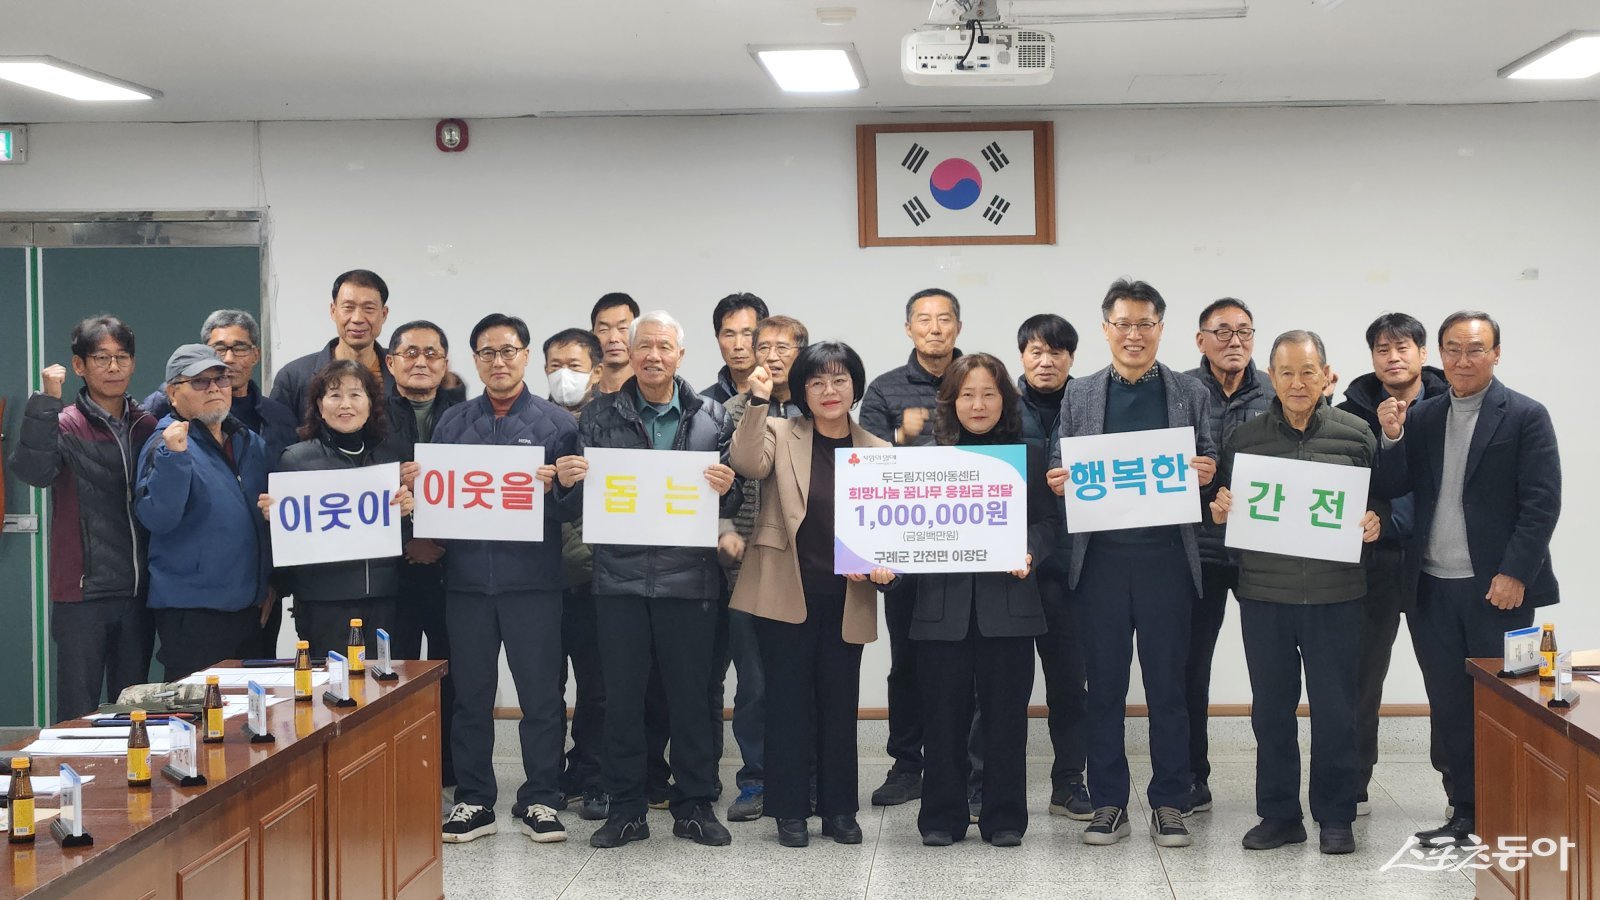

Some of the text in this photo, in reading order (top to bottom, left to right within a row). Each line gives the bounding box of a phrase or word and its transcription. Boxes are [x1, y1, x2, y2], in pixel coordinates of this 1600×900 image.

[882, 470, 980, 483] 두드림지역아동센터
[1069, 453, 1188, 502] 행복한
[423, 469, 535, 510] 이웃을
[848, 484, 1013, 500] 희망나눔 꿈나무 응원금 전달
[279, 489, 391, 533] 이웃이
[854, 500, 1008, 529] 1,000,000원
[902, 530, 959, 542] (금일백만원)
[874, 549, 988, 563] 구례군 간전면 이장단
